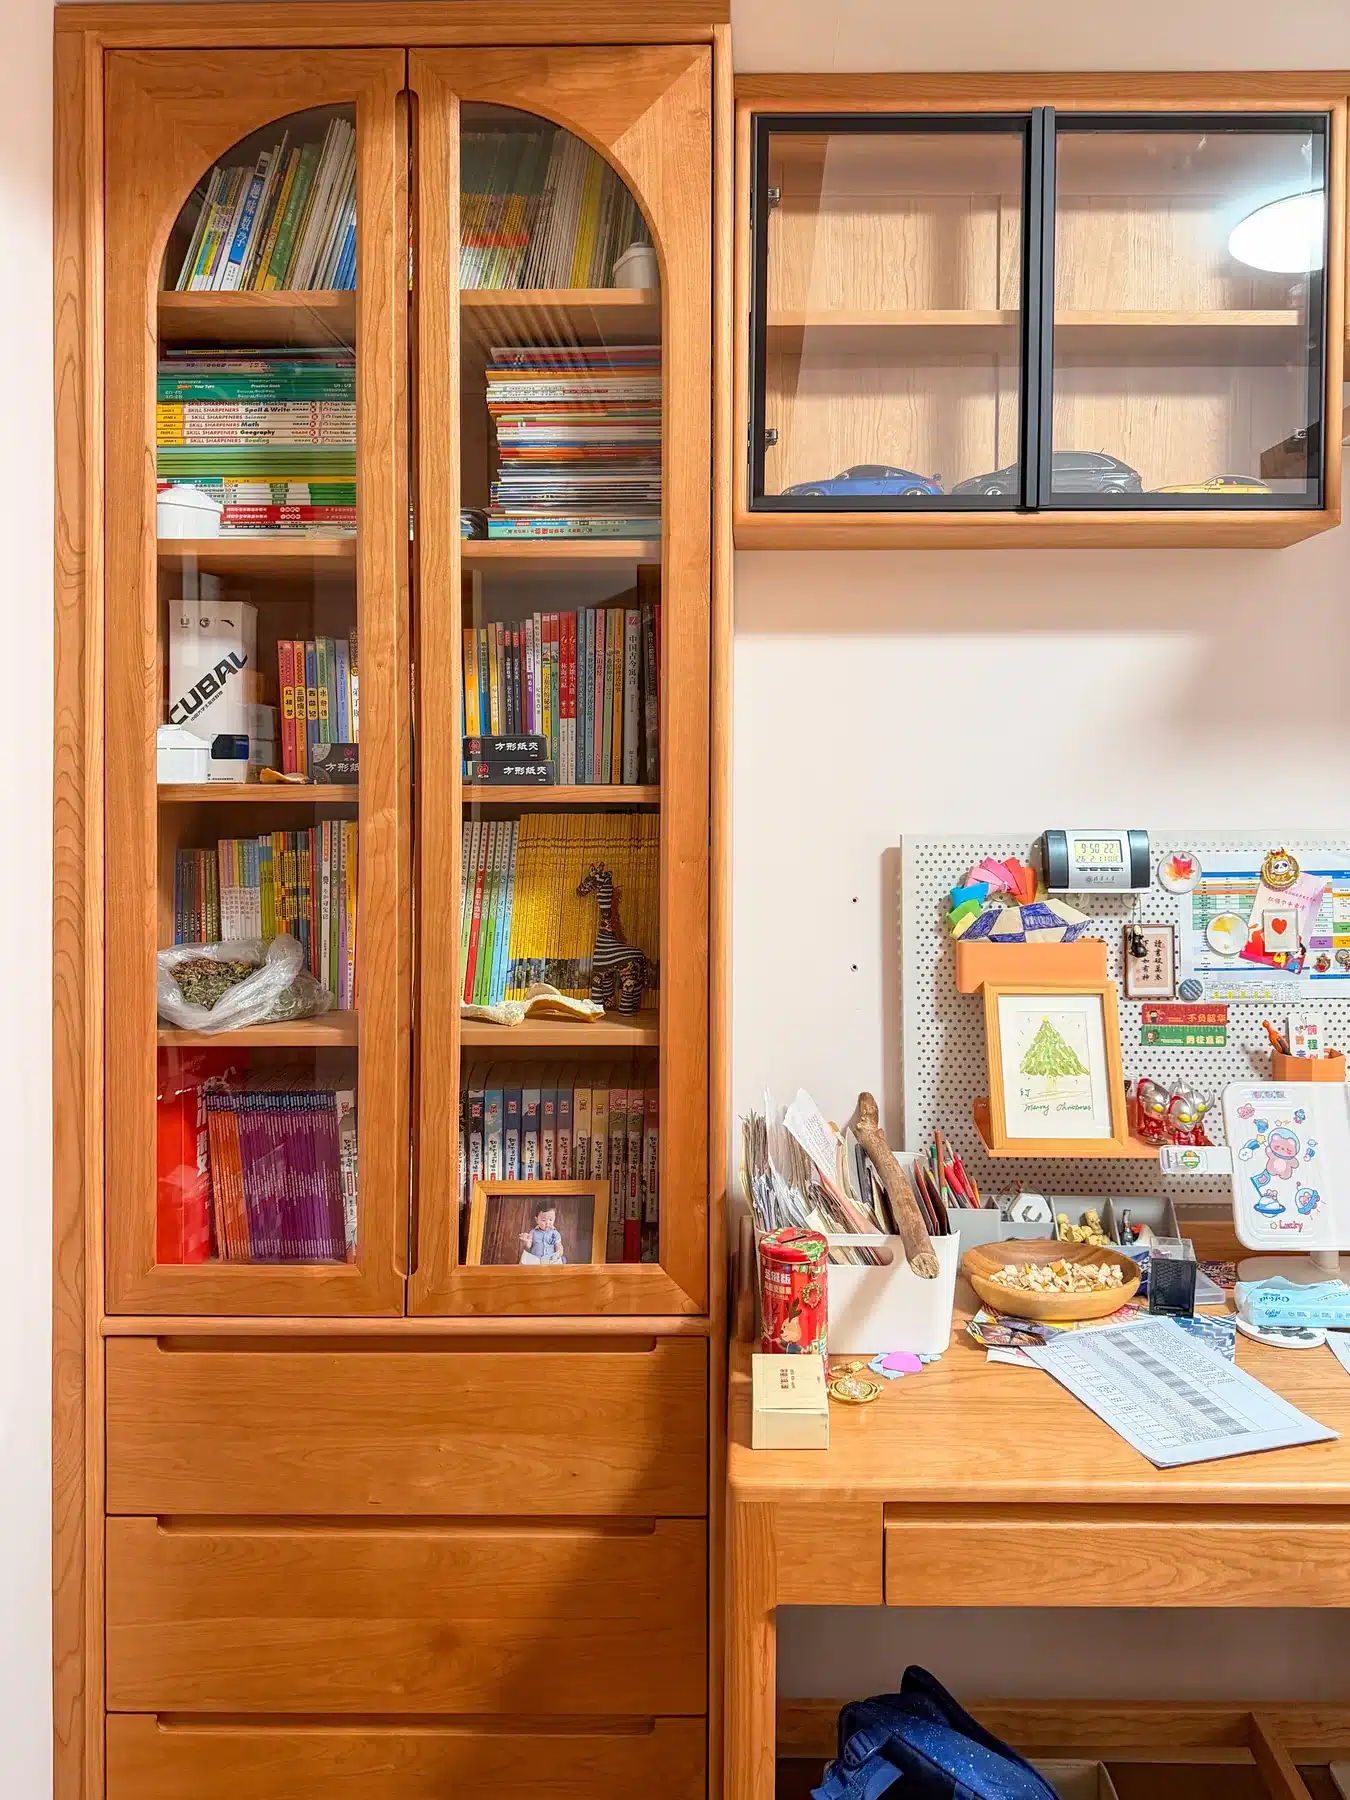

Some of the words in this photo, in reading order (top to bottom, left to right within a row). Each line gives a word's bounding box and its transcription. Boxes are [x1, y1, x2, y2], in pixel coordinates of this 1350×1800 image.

[629, 635, 637, 684] 中国古今寓言
[170, 652, 248, 725] CUBAL
[1142, 940, 1150, 981] 下如有神
[1187, 1013, 1226, 1023] 不负韶华
[1280, 1220, 1304, 1232] Lucky
